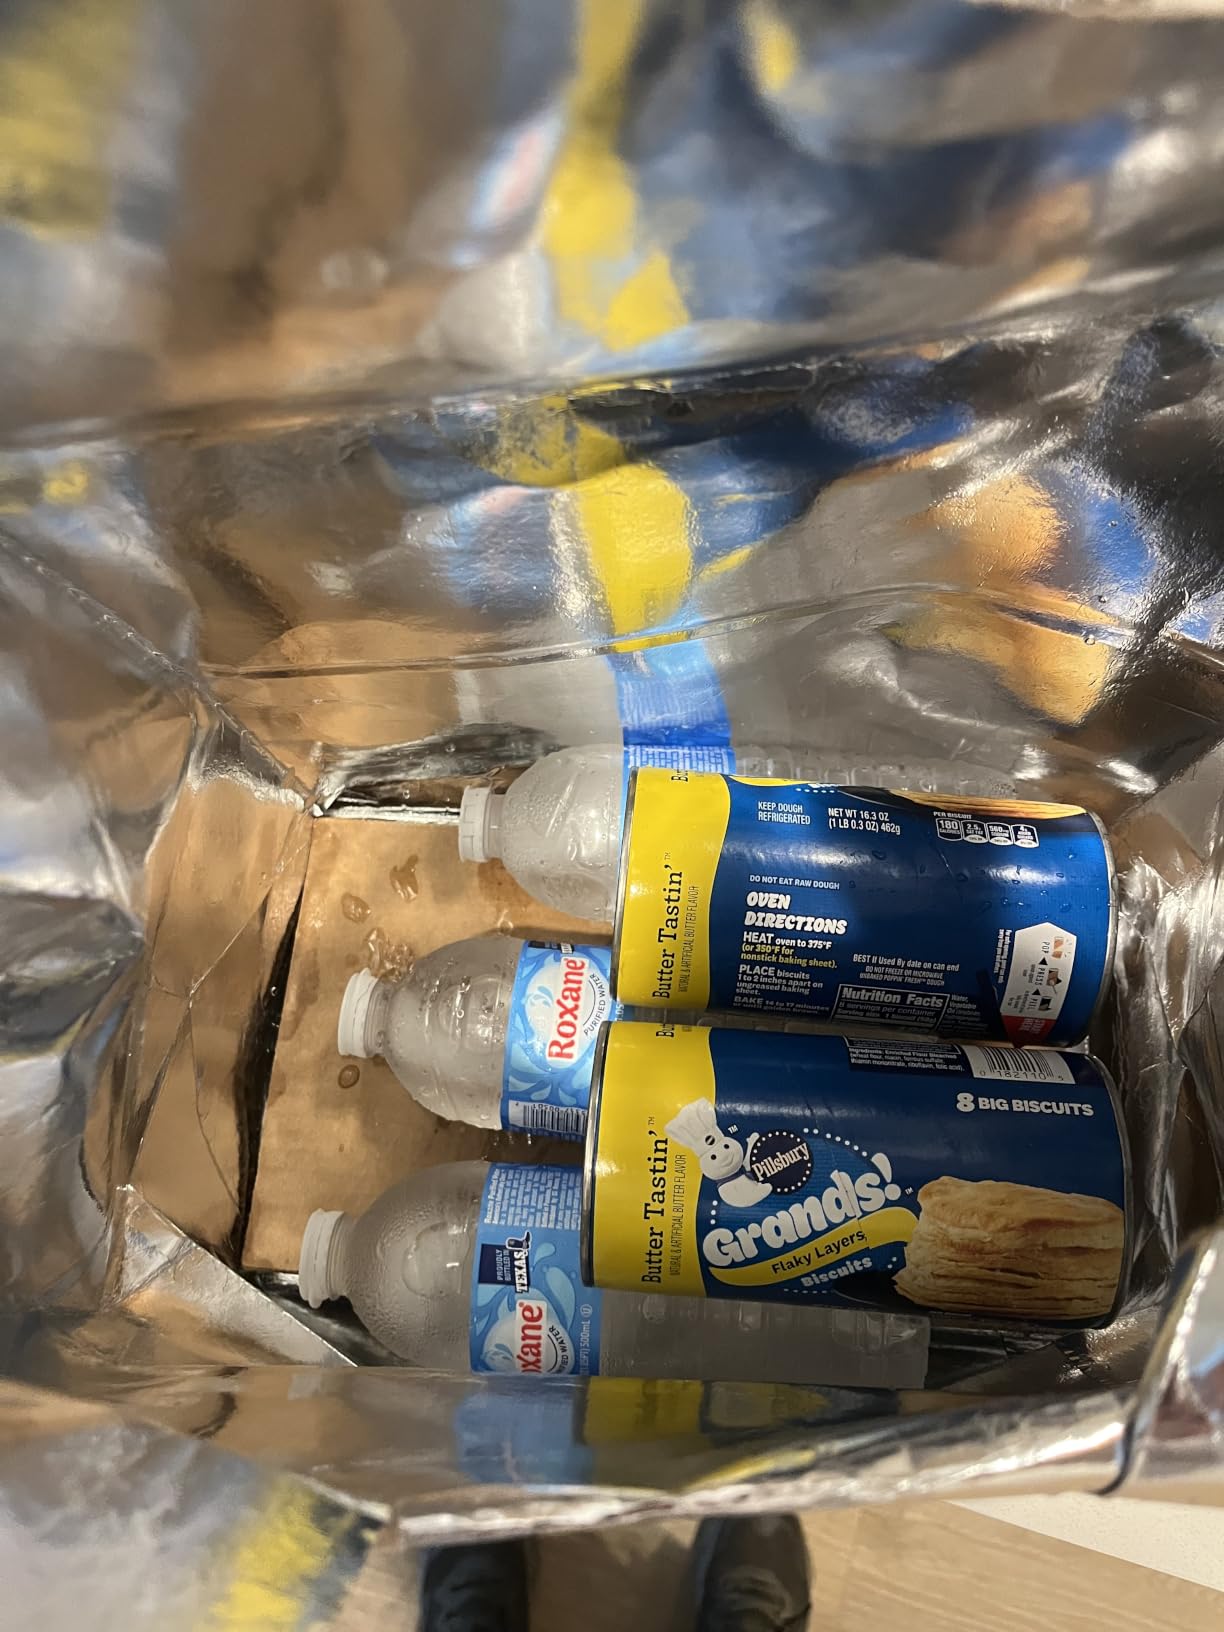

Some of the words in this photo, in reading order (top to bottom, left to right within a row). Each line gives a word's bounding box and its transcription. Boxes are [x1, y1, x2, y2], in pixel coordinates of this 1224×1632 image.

[758, 801, 776, 812] KEEP
[778, 803, 803, 814] DOUGH
[758, 811, 811, 825] REFRIGERATED
[828, 807, 843, 818] NET
[844, 809, 857, 819] WT
[860, 810, 877, 820] 16.3
[878, 812, 889, 822] OZ
[828, 818, 836, 829] (1
[838, 819, 850, 829] LB
[851, 820, 864, 830] 0.3
[865, 821, 879, 833] OZ)
[880, 822, 901, 835] 462g
[939, 820, 959, 830] 180
[750, 875, 761, 883] DO
[761, 876, 777, 885] NOT
[779, 877, 793, 886] EAT
[794, 878, 812, 887] RAW
[813, 880, 840, 890] DOUGH
[686, 886, 699, 911] FLAVOR
[746, 891, 791, 910] OVEN
[684, 912, 697, 938] BUTTER
[744, 911, 848, 935] DIRECTIONS
[742, 943, 755, 953] (or
[755, 944, 780, 954] 350°F
[781, 945, 794, 955] for
[743, 931, 774, 944] HEAT
[775, 938, 796, 947] oven
[797, 939, 807, 948] to
[807, 940, 832, 950] 375°F
[1041, 941, 1050, 954] POP
[741, 952, 778, 963] nonstick
[778, 954, 808, 968] baking
[808, 957, 838, 969] sheet).
[853, 954, 871, 963] BEST
[878, 956, 896, 965] Used
[897, 958, 906, 968] By
[907, 959, 921, 968] date
[946, 963, 960, 972] end
[652, 948, 675, 999] Butter
[739, 964, 775, 976] PLACE
[777, 969, 810, 980] biscuits
[743, 974, 752, 982] to
[760, 976, 787, 985] inches
[788, 979, 811, 989] apart
[885, 967, 904, 975] FREEZE
[912, 970, 944, 979] MICROWAVE
[1034, 967, 1045, 986] PRESS
[589, 973, 606, 998] WATER
[736, 981, 781, 992] ungreased
[781, 985, 810, 995] baking
[736, 988, 761, 996] sheet.
[841, 987, 901, 1004] Nutrition
[906, 994, 944, 1008] Facts
[548, 958, 586, 1060] Roxane
[583, 1000, 606, 1036] PURIFIED
[846, 1003, 880, 1012] servings
[881, 1005, 896, 1014] per
[897, 1008, 936, 1017] container
[956, 1093, 974, 1112] 8
[978, 1097, 1010, 1111] BIG
[1011, 1098, 1094, 1116] BISCUITS
[674, 1154, 687, 1183] FLAVOR
[751, 1142, 810, 1181] Pillsbury
[673, 1185, 685, 1212] BUTTER
[702, 1152, 902, 1266] Grands!
[671, 1215, 684, 1248] ARTIFICIAL
[641, 1226, 663, 1284] Butter
[772, 1252, 811, 1274] Flaky
[815, 1230, 866, 1260] Layers
[496, 1249, 504, 1281] PROUDLY
[513, 1249, 528, 1293] TEXAS
[800, 1256, 873, 1287] Biscuits
[549, 1325, 568, 1353] WATER
[580, 1319, 591, 1347] 500mL
